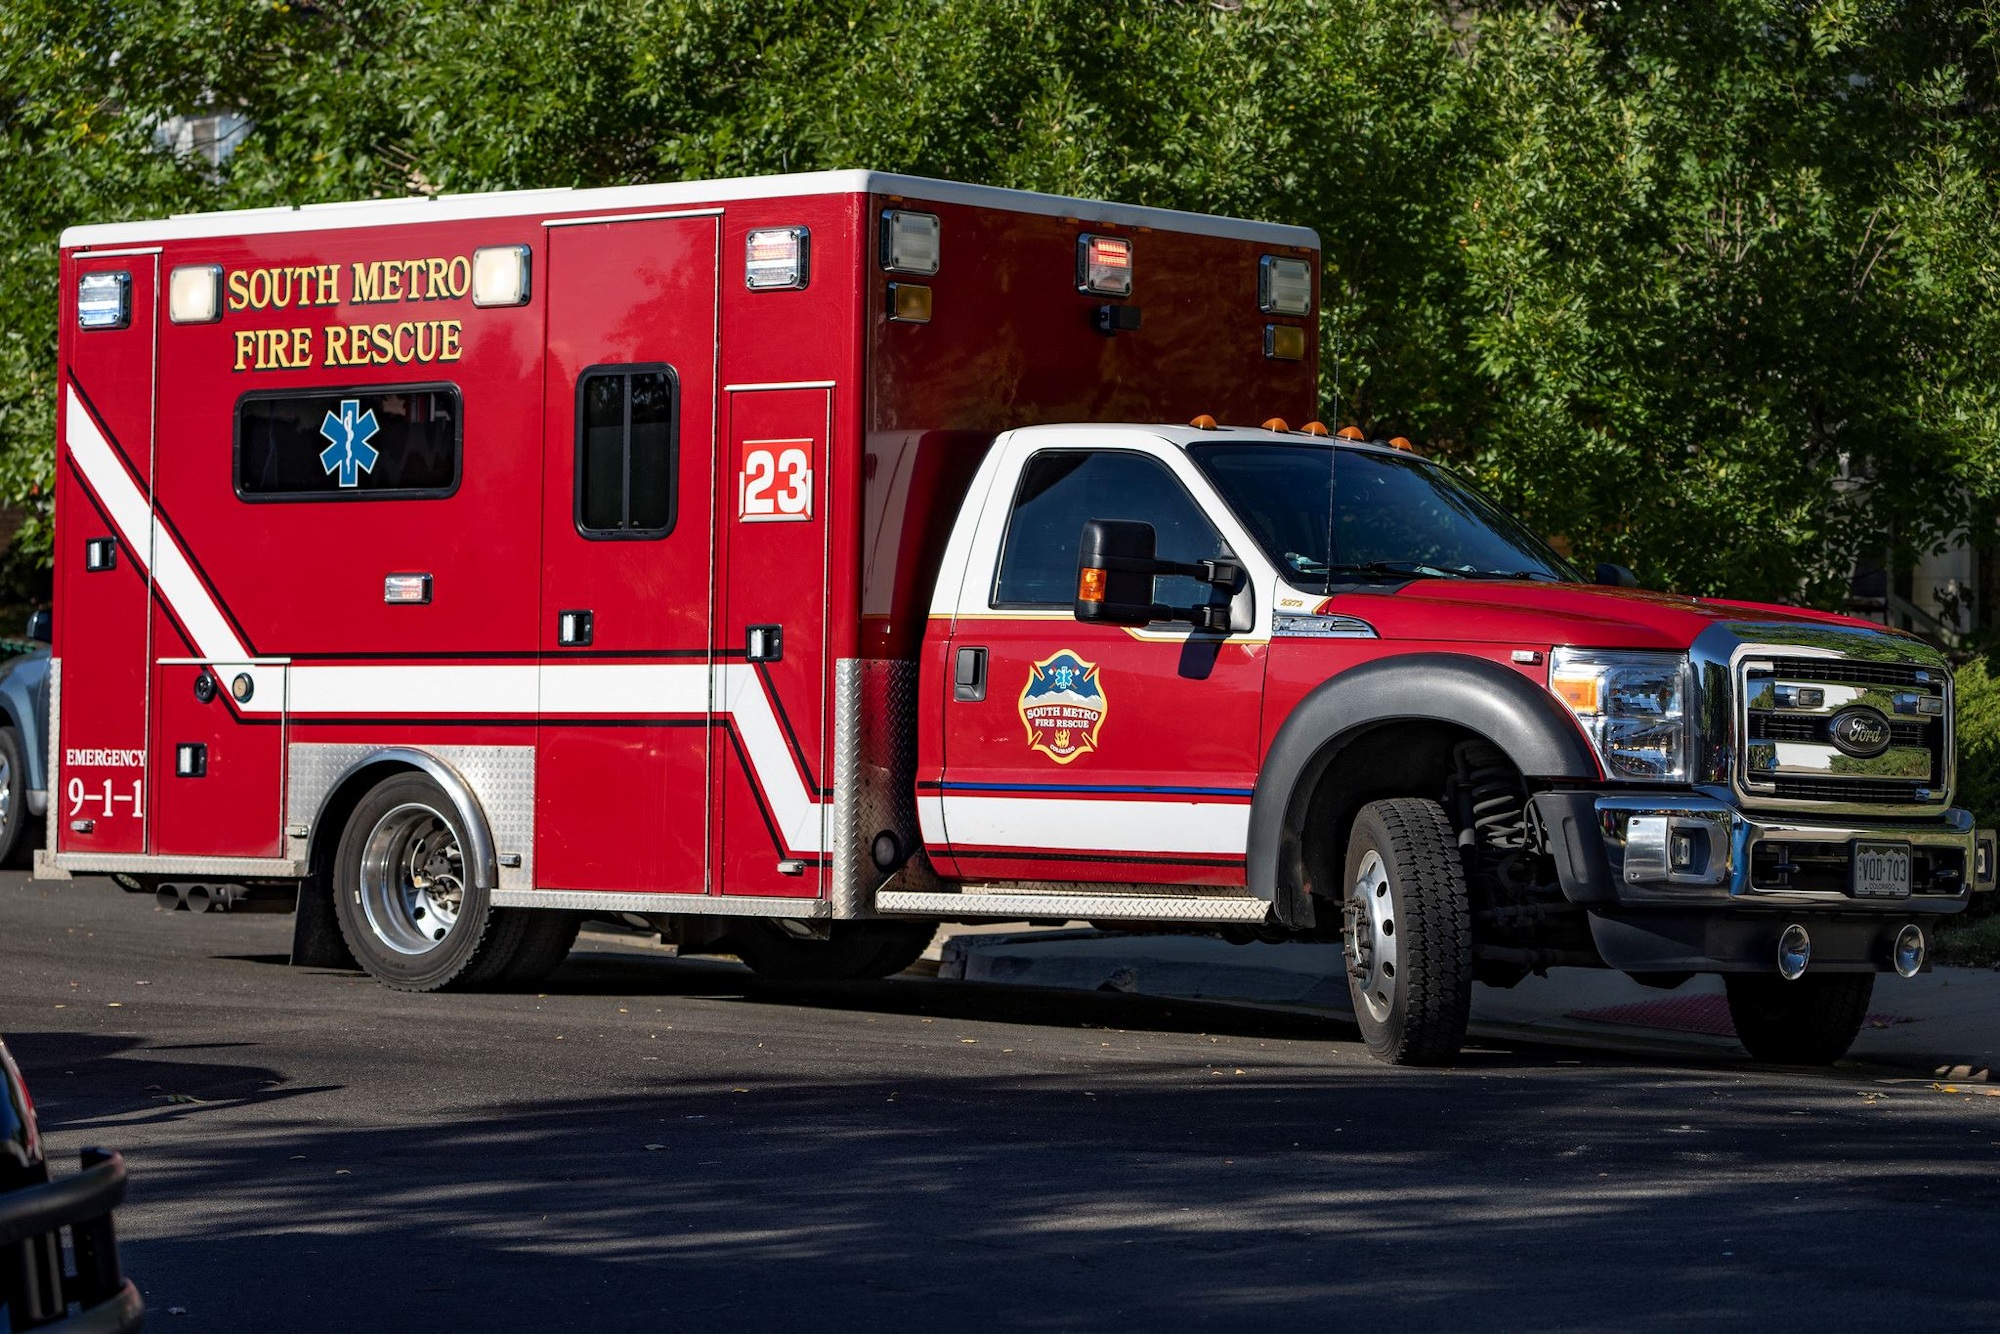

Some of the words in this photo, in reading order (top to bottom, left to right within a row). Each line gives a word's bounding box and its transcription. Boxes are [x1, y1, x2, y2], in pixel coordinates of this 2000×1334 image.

[228, 264, 341, 311] SOUTH
[351, 256, 472, 303] METRO
[233, 328, 313, 371] FIRE
[323, 320, 463, 367] RESCUE
[745, 448, 808, 514] 23
[1026, 707, 1061, 720] SOUTH
[1062, 707, 1099, 722] METRO
[1034, 718, 1055, 728] FIRE
[1056, 719, 1090, 729] RESCUE
[1849, 717, 1882, 743] Ford
[66, 749, 147, 767] EMERGENCY
[1049, 743, 1076, 755] COLORADO
[68, 777, 144, 818] 9-1-1
